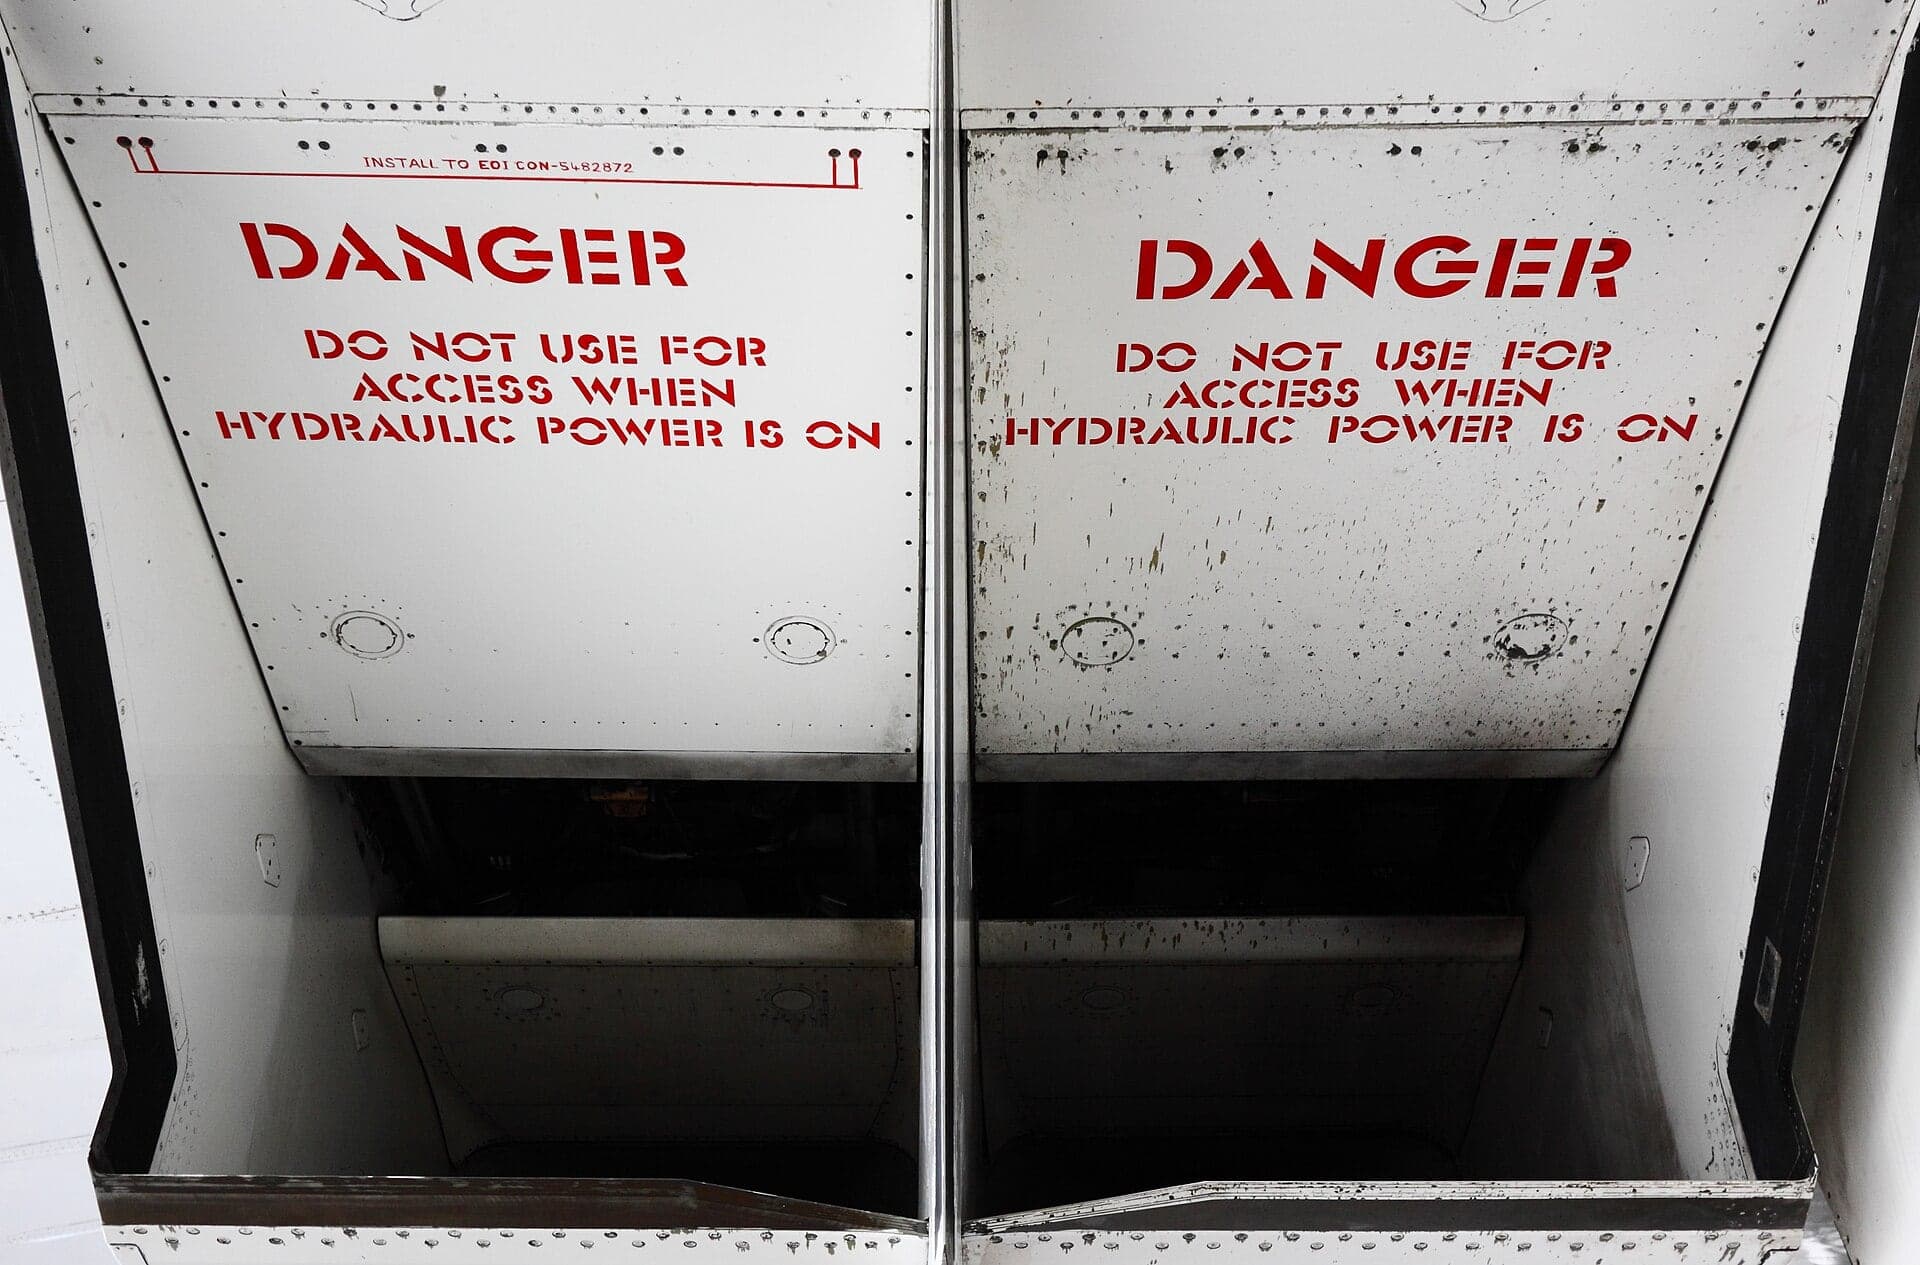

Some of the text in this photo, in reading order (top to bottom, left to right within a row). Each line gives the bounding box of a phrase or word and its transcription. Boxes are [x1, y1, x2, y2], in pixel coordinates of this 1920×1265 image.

[363, 155, 438, 169] INSTALL
[442, 158, 470, 171] TO
[240, 222, 688, 287] DANGER
[1136, 235, 1632, 300] DANGER
[304, 329, 766, 366] DO NOT USE FOR
[1116, 340, 1612, 372] DO NOT USE FOR
[353, 373, 735, 407] ACCESS WHEN
[1164, 378, 1552, 409] ACCESS WHEN
[215, 410, 881, 450] HYDRAULIC POWER IS ON
[1005, 413, 1698, 446] HYDRAULIC POWER IS ON
